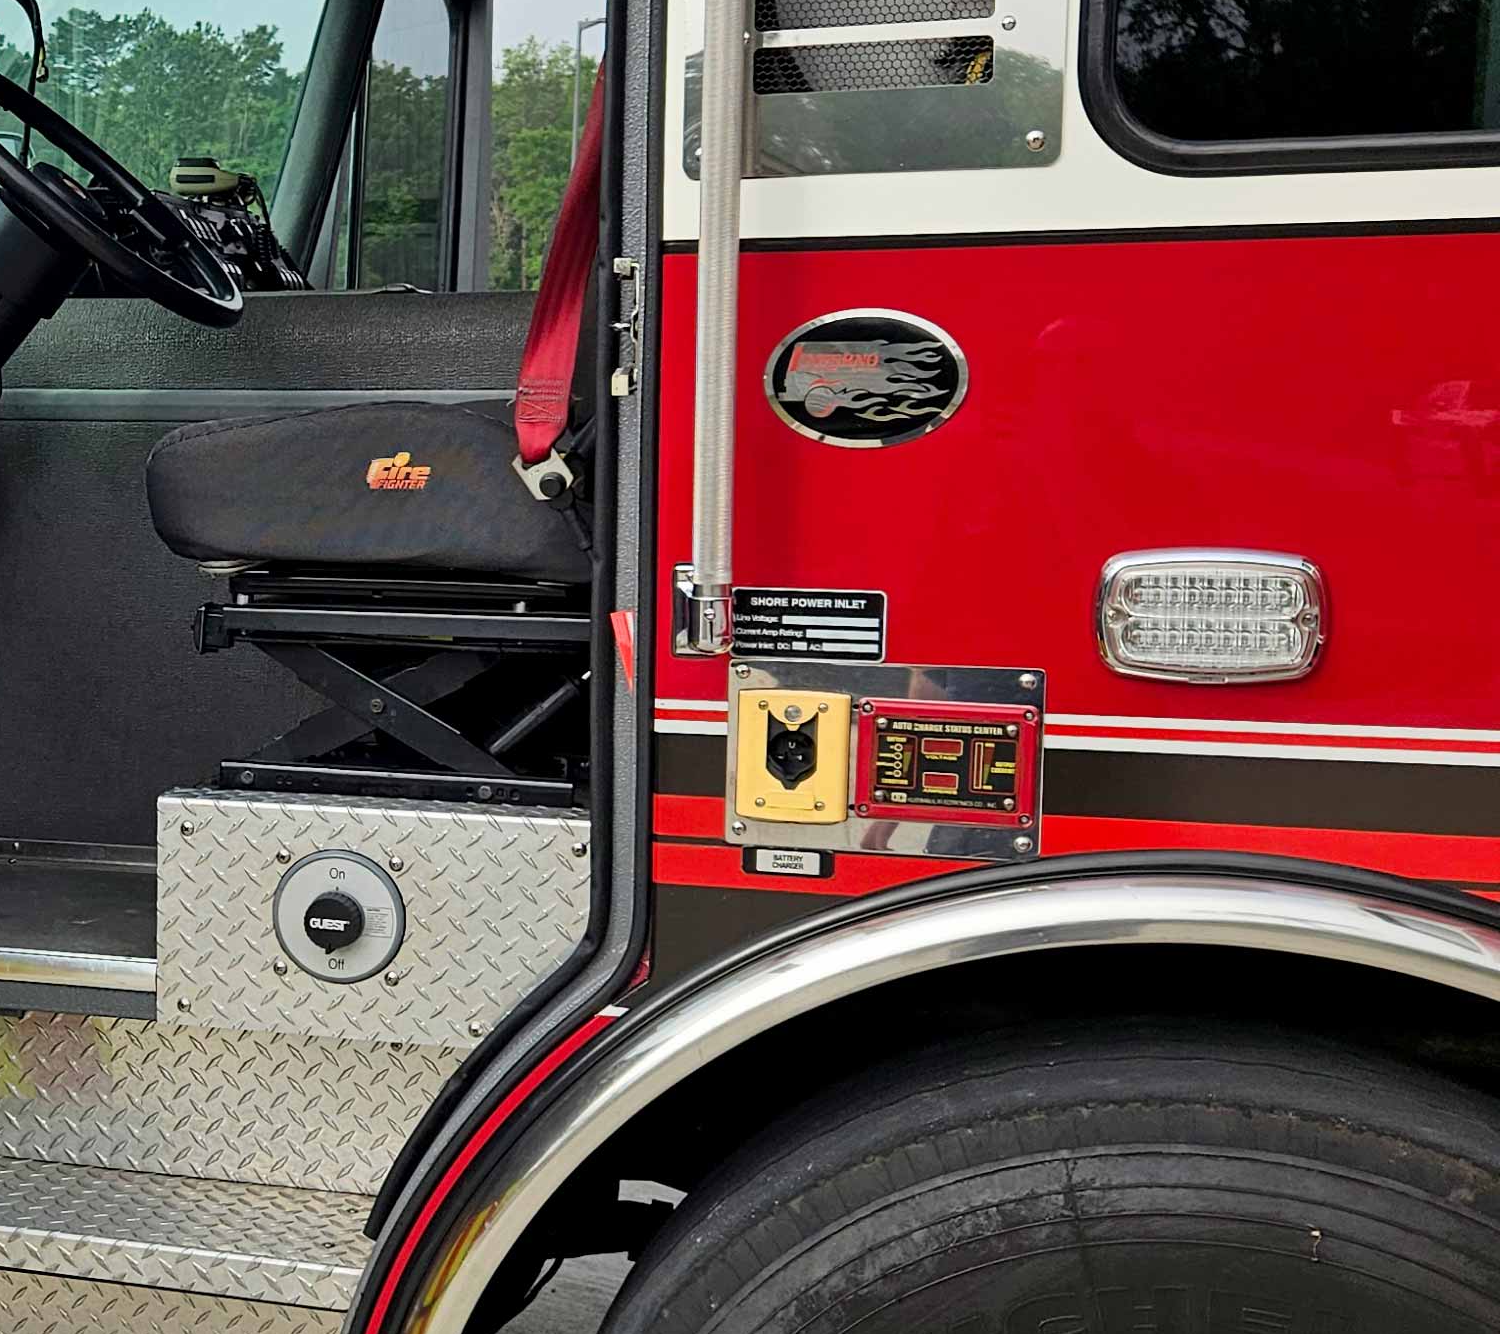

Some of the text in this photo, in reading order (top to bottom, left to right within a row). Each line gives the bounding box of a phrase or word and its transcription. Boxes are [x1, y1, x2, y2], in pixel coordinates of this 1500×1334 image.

[366, 452, 431, 487] Fire
[379, 479, 427, 489] FIGHTER
[750, 596, 867, 609] SHORE POWER INLET
[762, 628, 778, 637] Amp
[735, 641, 757, 649] Power
[777, 642, 791, 650] DC:
[809, 643, 822, 651] AC:
[892, 721, 1003, 736] AUTO CHARGE STATUS CENTER
[773, 854, 803, 862] BATTERY
[772, 861, 804, 869] CHARGER
[329, 867, 345, 880] On
[309, 917, 348, 932] GUEST
[328, 958, 345, 970] Off
